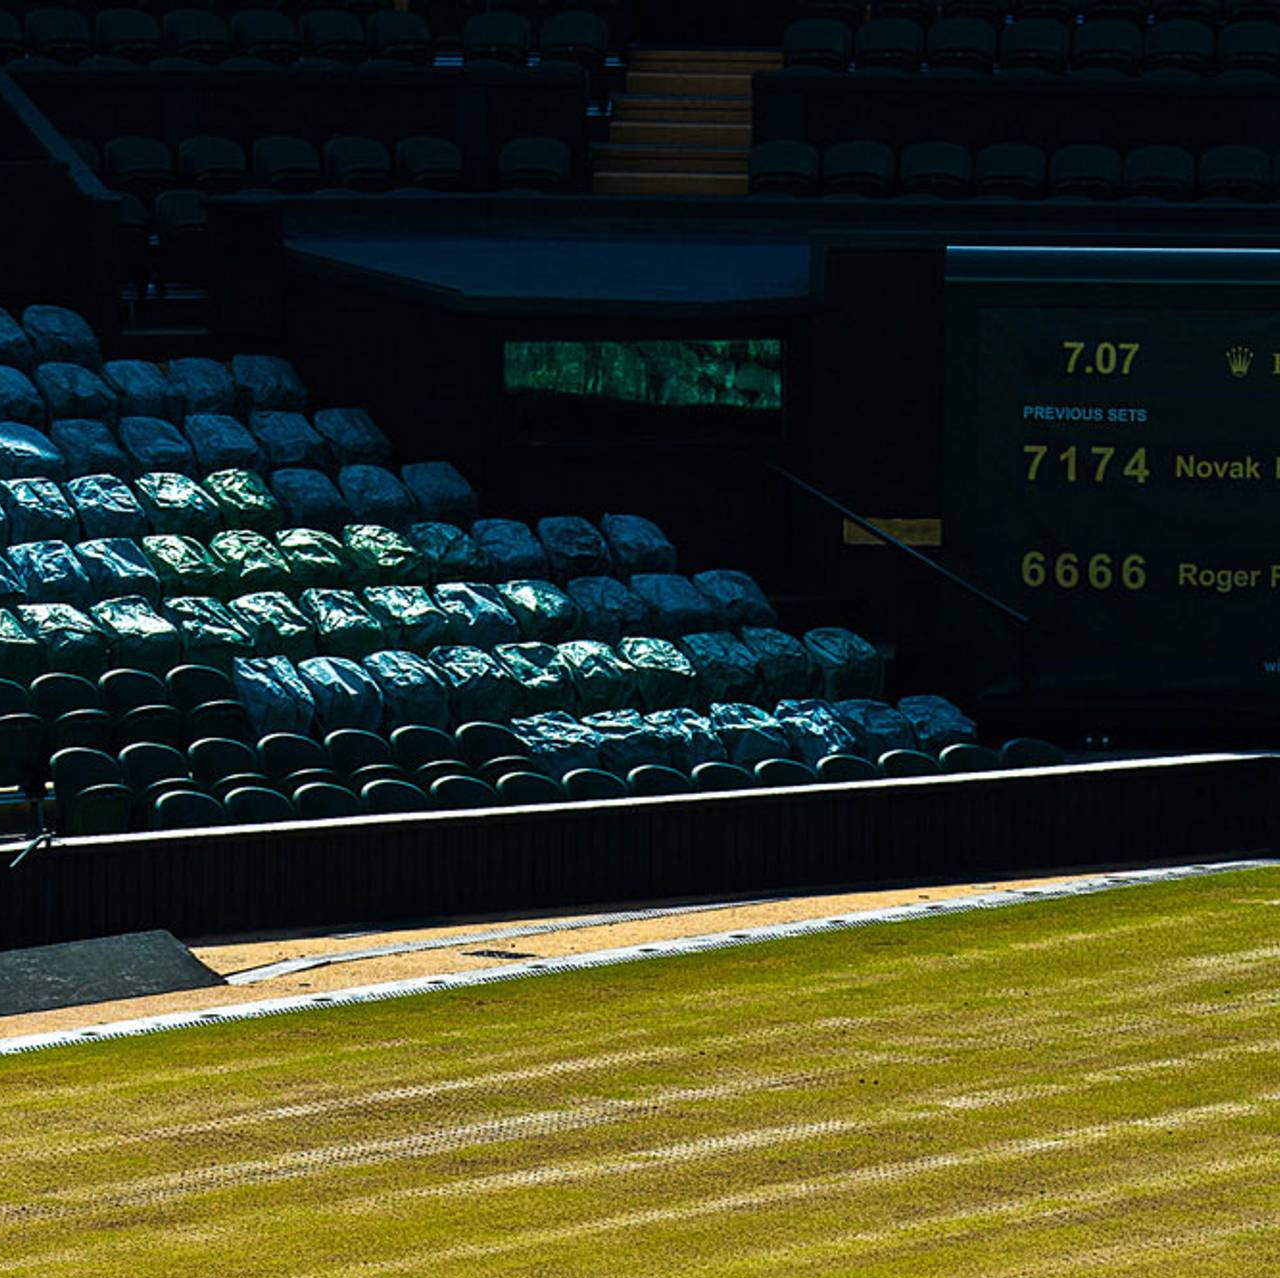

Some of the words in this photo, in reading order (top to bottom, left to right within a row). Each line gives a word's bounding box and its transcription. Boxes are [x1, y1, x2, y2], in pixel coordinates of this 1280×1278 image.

[1064, 342, 1139, 374] 7.07
[1024, 406, 1103, 420] PREVIOUS
[1108, 408, 1147, 422] SETS
[1177, 456, 1260, 478] Novak
[1179, 564, 1260, 592] Roger
